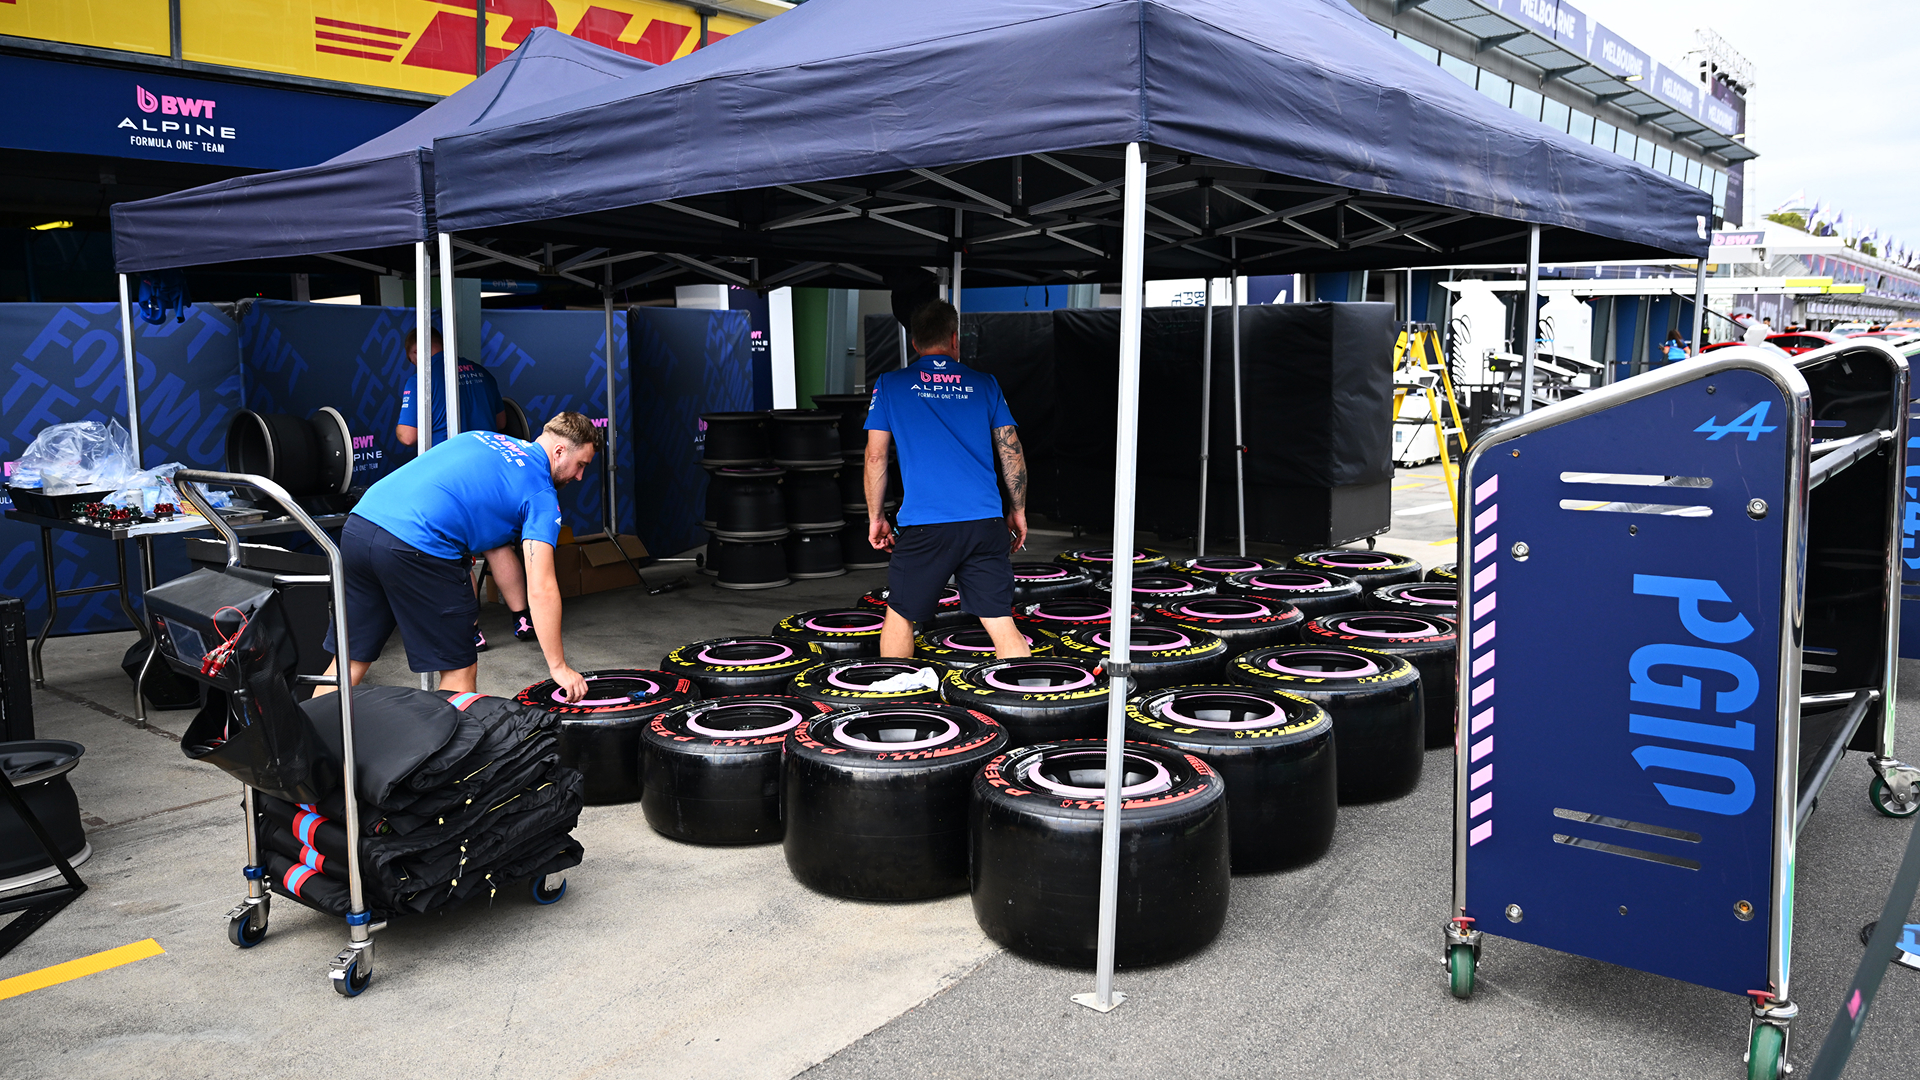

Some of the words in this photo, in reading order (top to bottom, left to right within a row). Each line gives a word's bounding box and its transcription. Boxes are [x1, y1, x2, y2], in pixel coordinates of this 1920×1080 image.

[1602, 37, 1643, 76] MELBOURNE
[1662, 75, 1694, 110] MELBOURNE
[161, 94, 216, 119] BWT
[117, 116, 236, 139] ALPINE
[130, 135, 173, 149] FORMULA
[201, 142, 225, 153] TEAM
[1724, 234, 1759, 246] BWT
[911, 383, 974, 393] ALPINE
[933, 373, 962, 384] BWT
[353, 435, 374, 449] BWT
[474, 430, 526, 468] ALPINE
[500, 440, 529, 457] BWT
[353, 450, 383, 461] PINE
[1060, 635, 1101, 653] ZERO
[1237, 663, 1301, 681] ZERO
[1628, 573, 1760, 816] PG10
[650, 713, 677, 737] ZERO
[1125, 704, 1173, 730] ZERO
[794, 721, 825, 749] ZERO
[820, 747, 847, 755] P
[984, 754, 1011, 788] ZERO
[1183, 754, 1216, 778] PIRELLI
[1004, 787, 1032, 797] P
